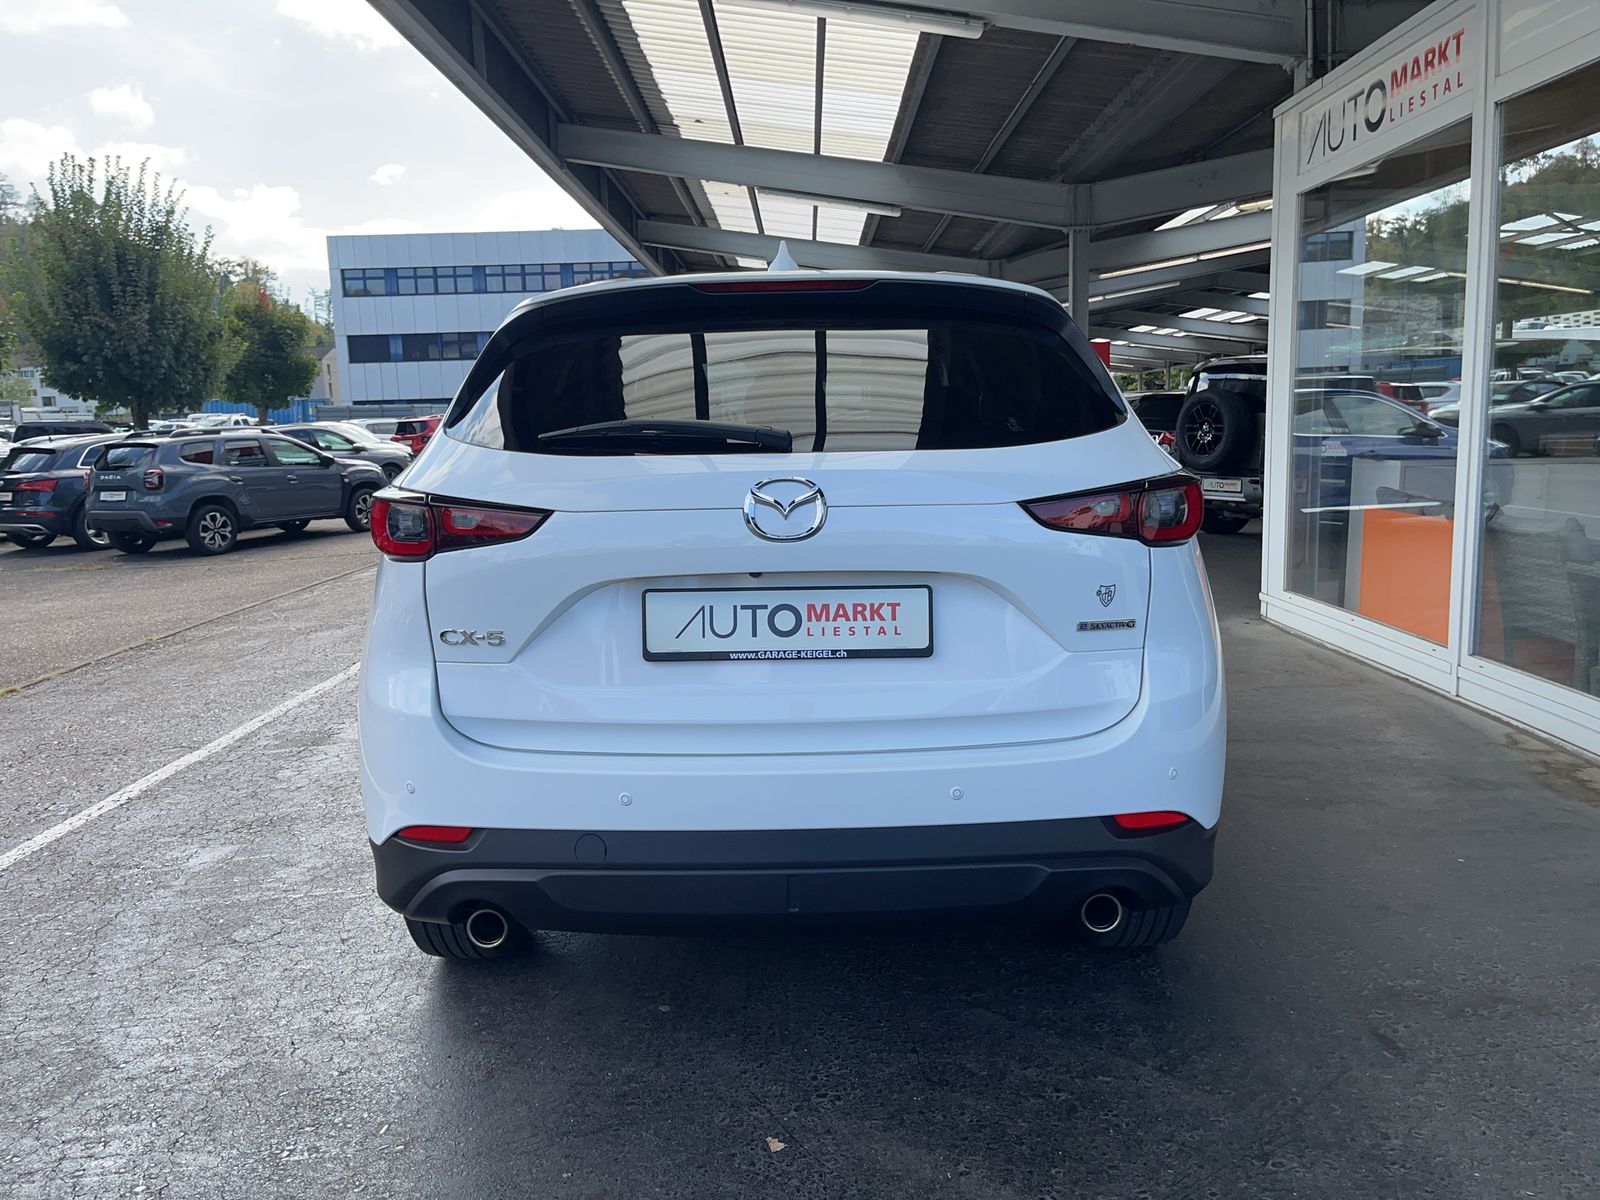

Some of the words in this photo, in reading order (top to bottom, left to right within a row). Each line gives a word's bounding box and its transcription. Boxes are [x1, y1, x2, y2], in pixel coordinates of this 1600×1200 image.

[1307, 78, 1387, 165] AUTO
[1390, 28, 1465, 92] MARKT
[1389, 71, 1463, 123] LIESTAL
[674, 603, 802, 639] AUTO
[806, 602, 901, 623] MARKT
[806, 626, 902, 637] LIESTAL
[439, 628, 506, 647] CX-5
[729, 649, 848, 660] www.GARAGE-KEIGEL.ch
